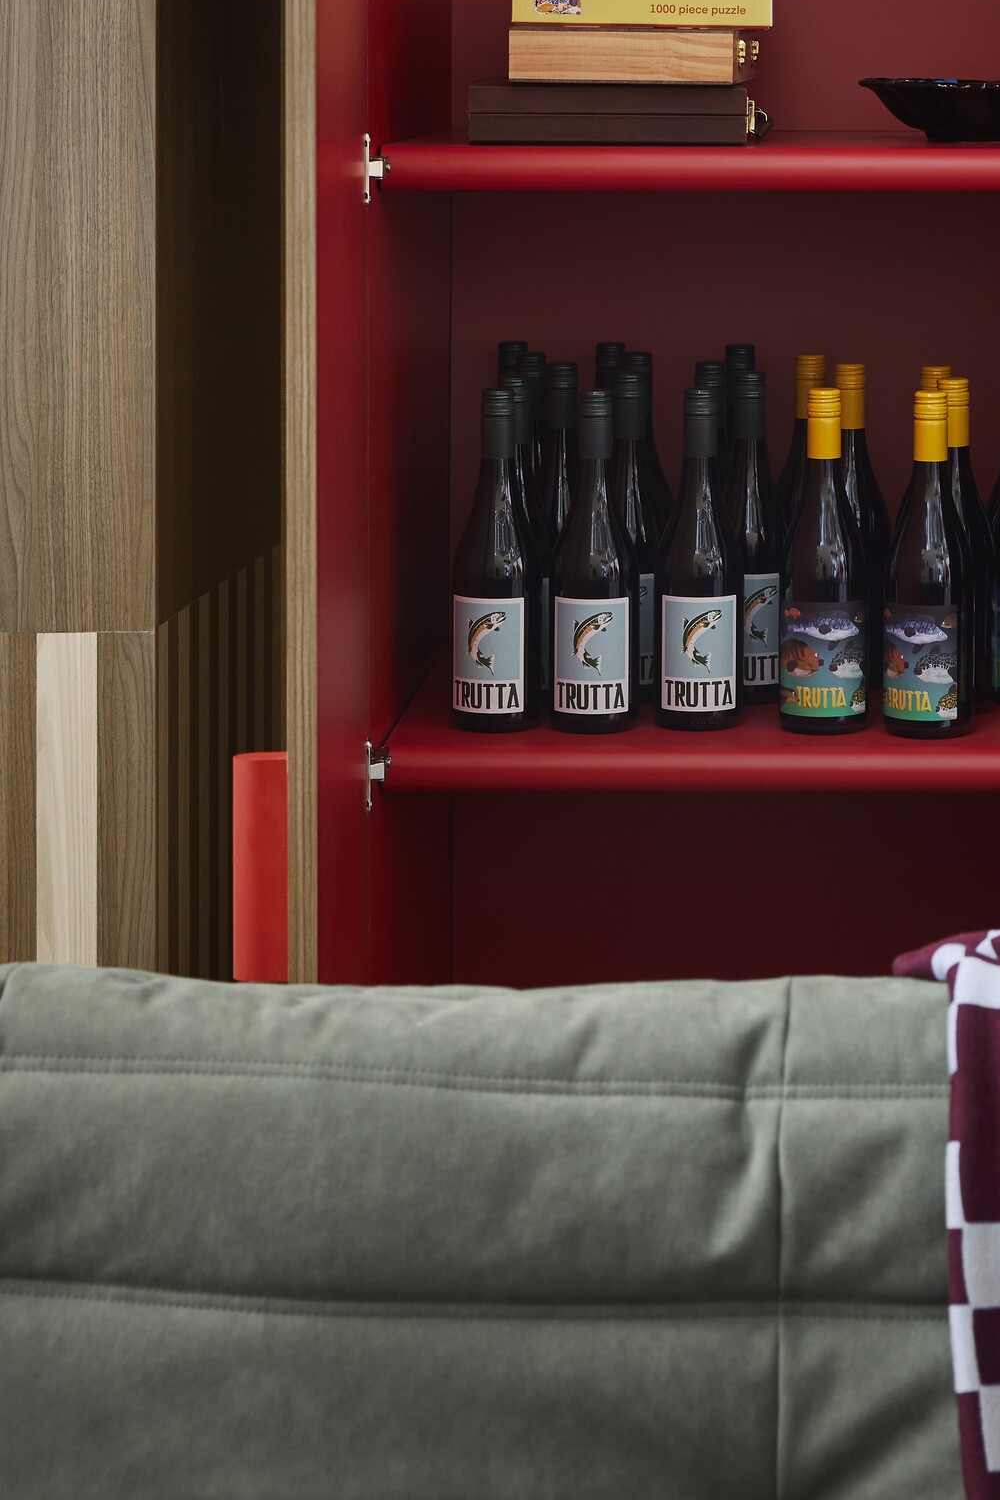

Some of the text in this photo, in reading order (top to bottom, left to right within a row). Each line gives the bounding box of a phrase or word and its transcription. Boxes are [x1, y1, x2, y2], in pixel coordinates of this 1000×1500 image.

[650, 4, 746, 16] 1000 piece puzzle
[454, 680, 519, 709] TRUTTA
[557, 681, 625, 710] TRUTTA
[664, 679, 733, 707] TRUTTA
[796, 685, 847, 708] TRUTTA
[887, 686, 932, 712] TRUTTA
